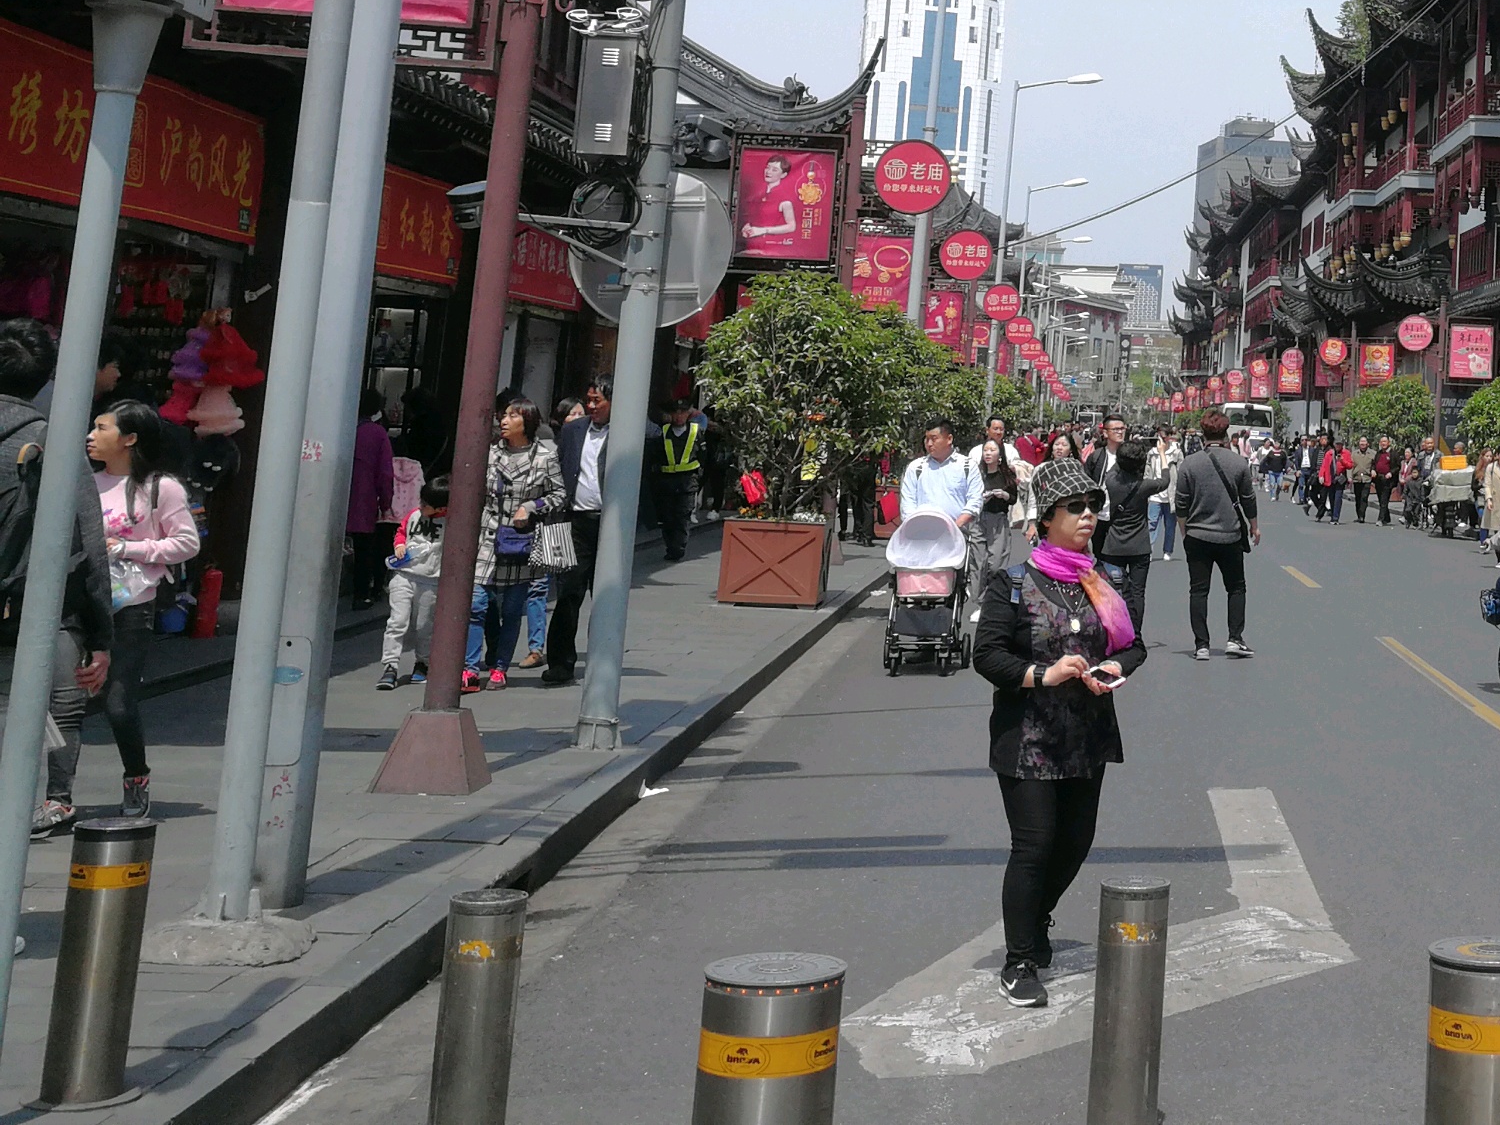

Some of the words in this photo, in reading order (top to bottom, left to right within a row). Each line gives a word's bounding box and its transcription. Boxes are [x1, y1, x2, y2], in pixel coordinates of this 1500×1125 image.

[909, 161, 944, 182] 老庙
[883, 183, 941, 195] 给您带来好运气
[964, 244, 988, 258] 老庙
